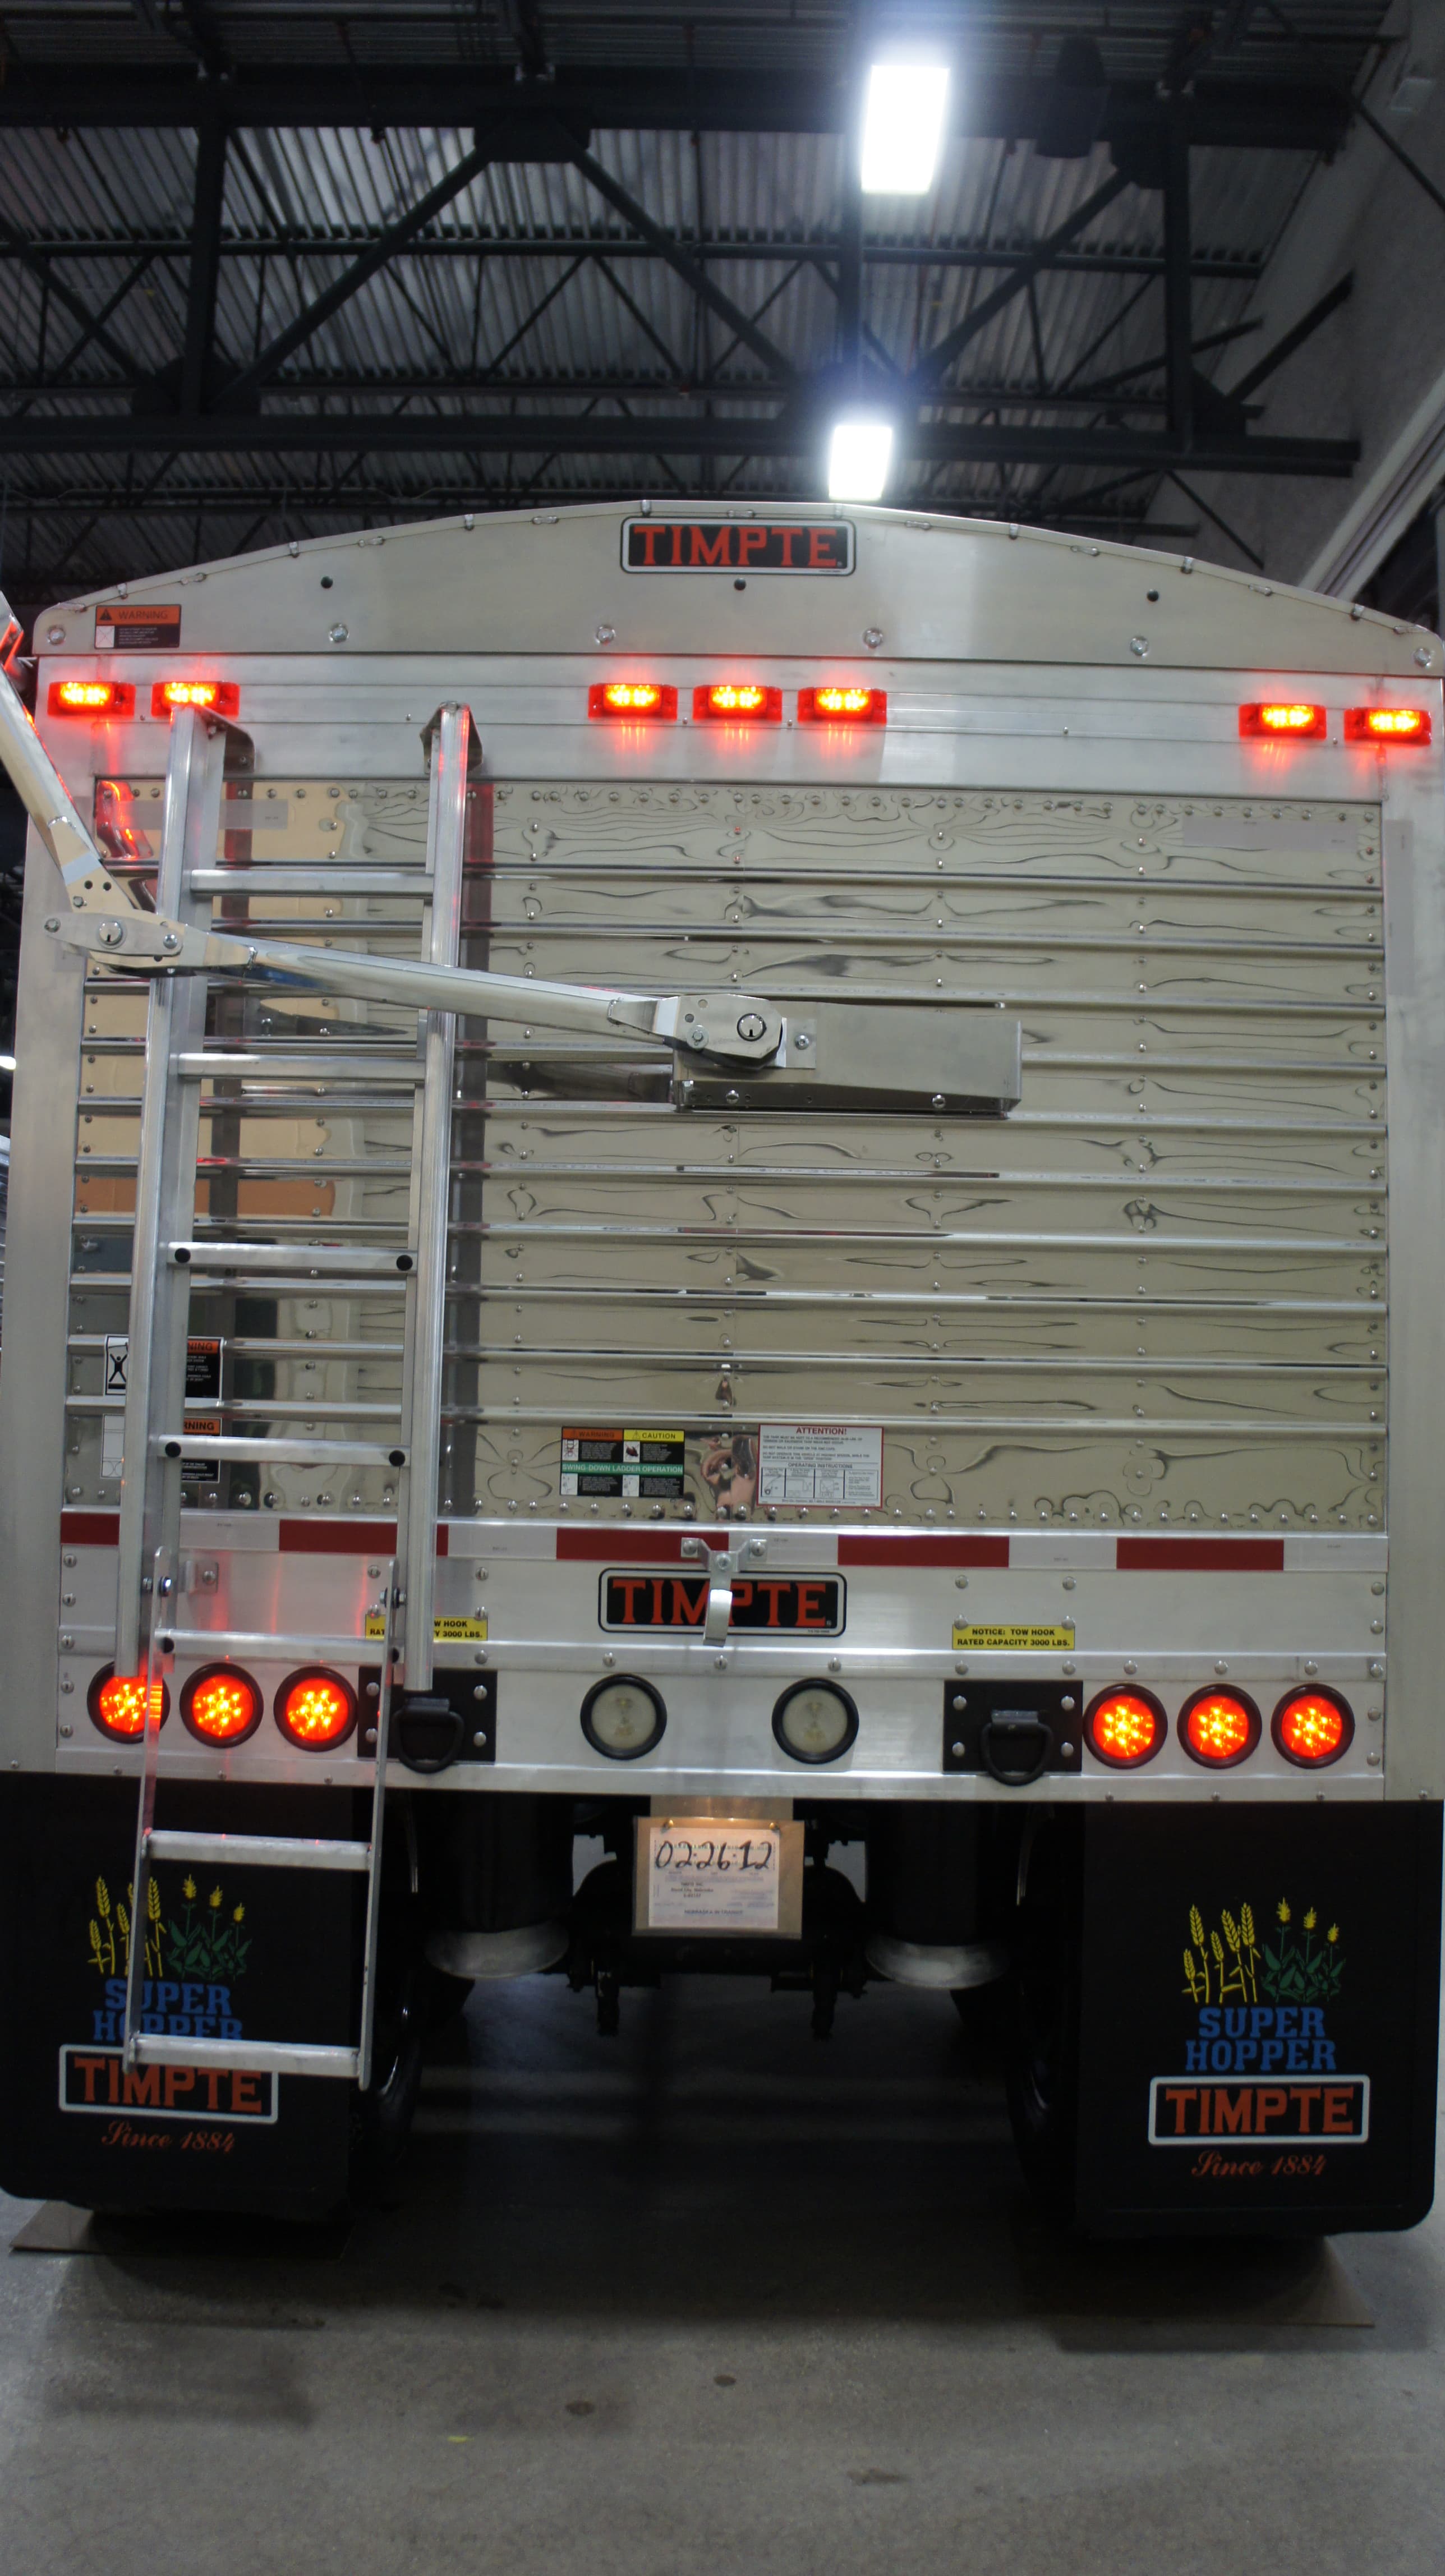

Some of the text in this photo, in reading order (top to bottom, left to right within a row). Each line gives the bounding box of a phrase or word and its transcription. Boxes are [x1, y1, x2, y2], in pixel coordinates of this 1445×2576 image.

[634, 525, 837, 567] TIMPTE
[118, 610, 168, 619] WARNING
[187, 1341, 213, 1351] NING
[184, 1422, 214, 1430] RNING
[1199, 2007, 1325, 2037] SUPER
[1185, 2040, 1336, 2071] HOPPER
[1166, 2087, 1354, 2134] TIMPTE
[102, 2120, 235, 2152] Since 1884
[1191, 2150, 1328, 2177] Since 1884
